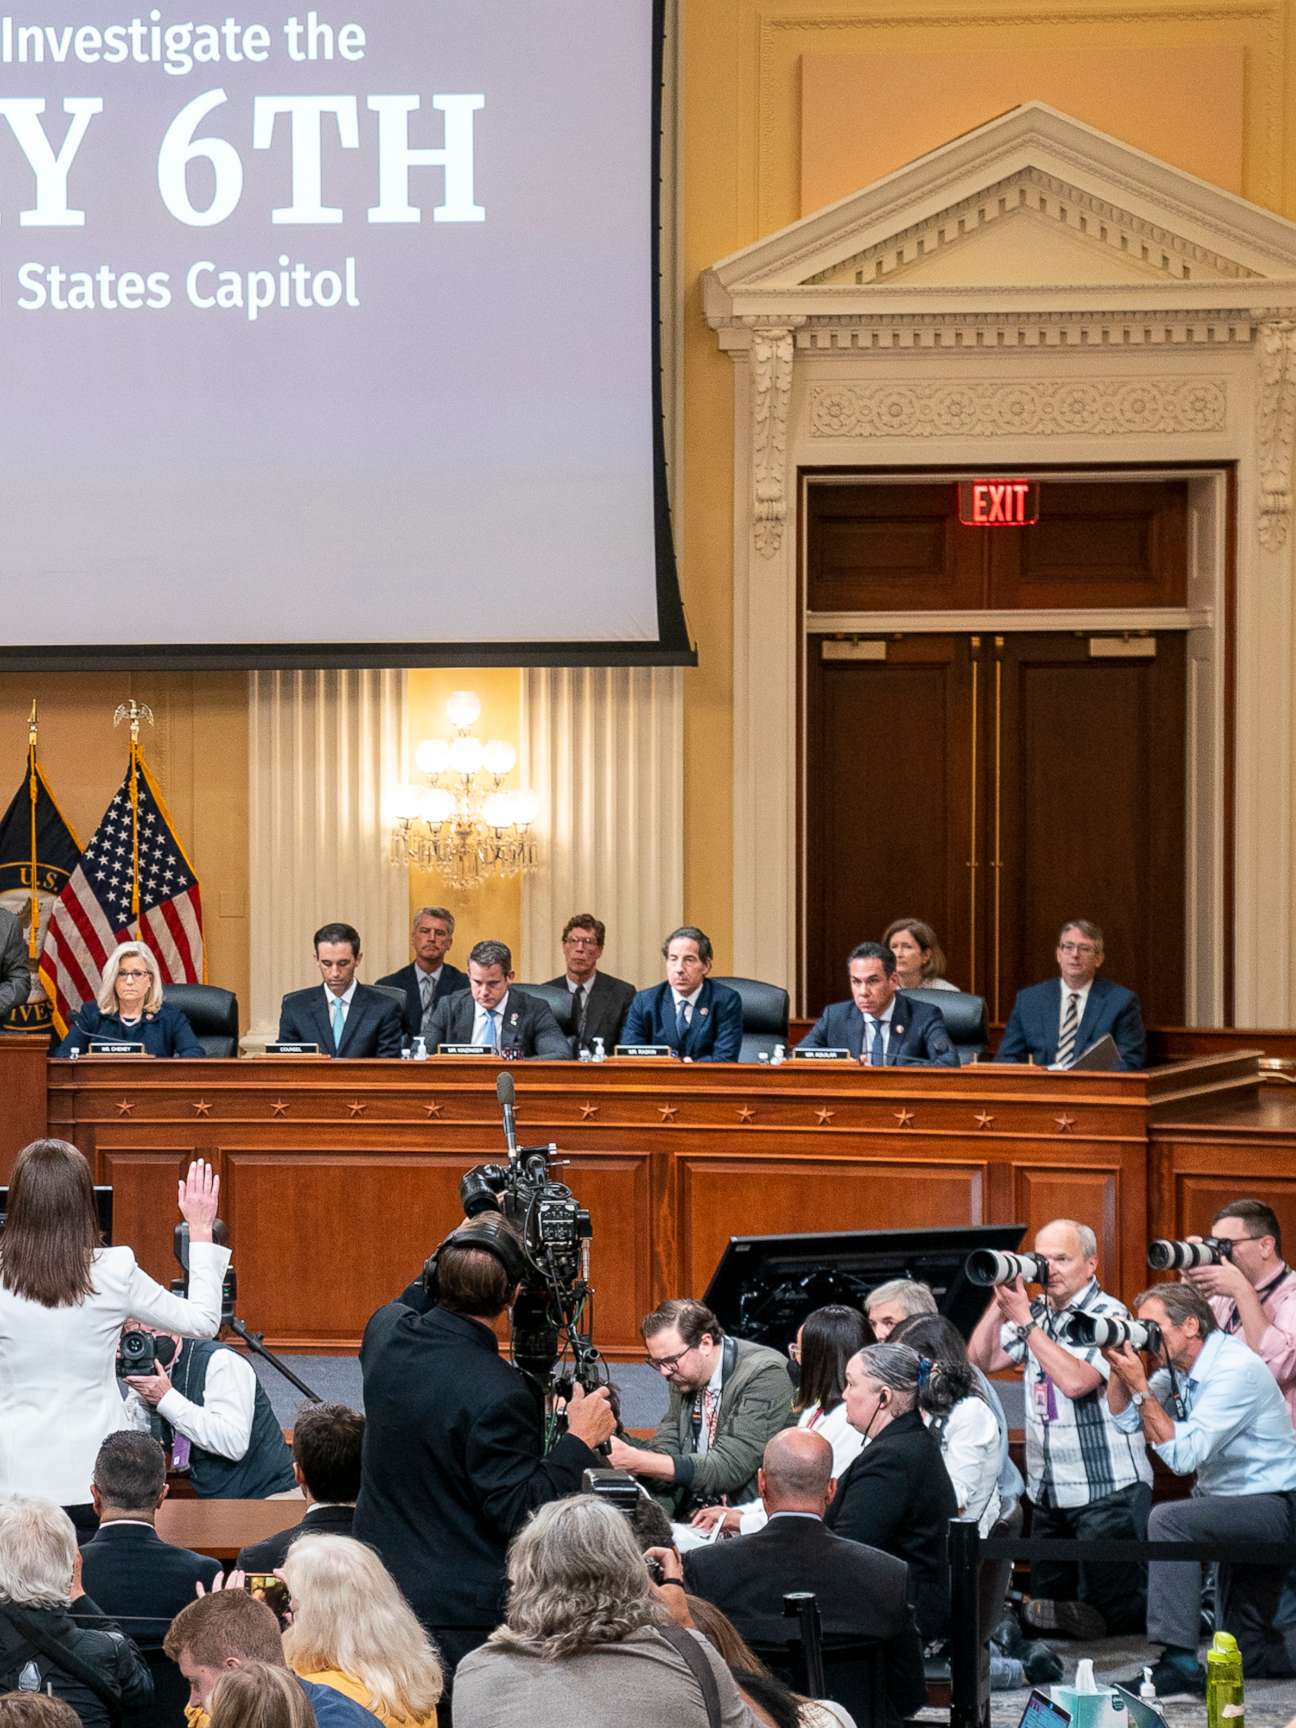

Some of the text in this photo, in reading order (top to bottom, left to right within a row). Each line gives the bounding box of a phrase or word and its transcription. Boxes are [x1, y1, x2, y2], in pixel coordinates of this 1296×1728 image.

[2, 10, 271, 75] Investigate
[284, 12, 366, 60] the
[157, 88, 486, 227] 6TH
[17, 262, 172, 310] States
[186, 255, 360, 320] Capitol
[973, 484, 1029, 521] EXIT
